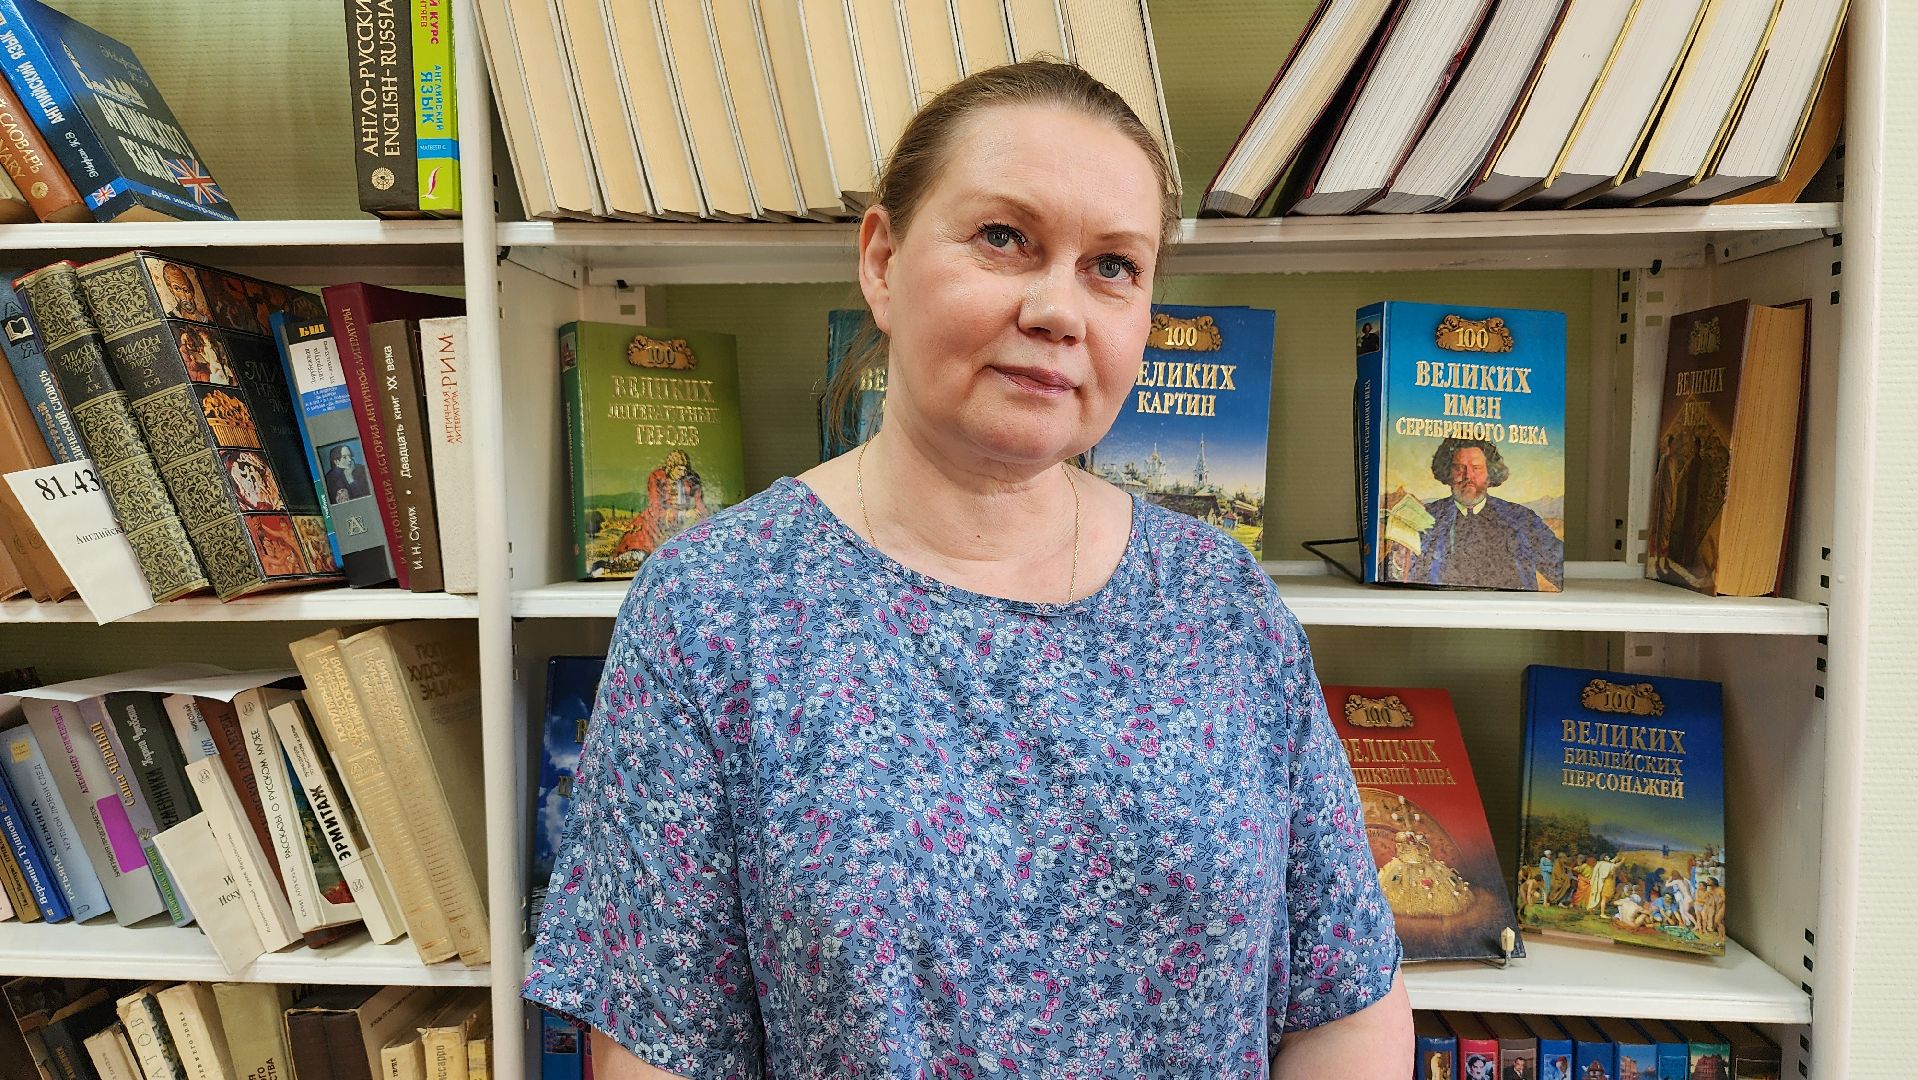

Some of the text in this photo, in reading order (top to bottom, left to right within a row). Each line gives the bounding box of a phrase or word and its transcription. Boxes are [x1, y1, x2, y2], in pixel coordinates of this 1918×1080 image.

[430, 12, 439, 45] КУРС
[0, 30, 65, 125] АНГЛИЙСКИЙ ЯЗЫК
[420, 72, 434, 124] ЯЗЫК
[434, 65, 444, 131] АНГЛИЙСКИЙ
[0, 112, 43, 174] СЛОВАРЬ
[92, 92, 195, 161] АНГЛИЙСКОГО
[340, 305, 365, 366] ЛИТЕРАТУРЫ
[1164, 326, 1199, 347] 100
[1455, 328, 1489, 349] 100
[381, 344, 395, 372] века
[648, 346, 676, 366] 100
[39, 369, 62, 412] СЛОВАРЬ
[610, 375, 716, 403] ВЕЛИКИХ
[1136, 361, 1237, 391] ЕЛИКИХ
[1415, 360, 1532, 394] ВЕЛИКИХ
[1676, 367, 1727, 396] ВЕЛИКИХ
[354, 366, 379, 421] АНТИЧНОЙ
[389, 395, 402, 420] книг
[1137, 390, 1217, 417] КАРТИН
[1443, 393, 1502, 420] ИМЕН
[443, 391, 454, 443] АНТИЧНАЯ
[451, 391, 462, 443] ЛИТЕРАТУРА
[607, 402, 720, 425] ЛИТЕРАТУРНЫХ
[634, 424, 701, 447] ГЕРОЕВ
[1395, 416, 1549, 446] СЕРЕБРЯНОГО ВЕКА
[368, 423, 390, 474] ИСТОРИЯ
[391, 422, 413, 480] Двадцать
[35, 469, 100, 500] 81.43
[404, 504, 422, 541] Сухих
[410, 541, 422, 555] Н.
[411, 557, 425, 570] И.
[314, 671, 349, 743] ПОПУЛЯРНАЯ
[330, 656, 371, 743] ЭНЦИКЛОПЕДИЯ
[1364, 706, 1393, 726] 100
[1604, 691, 1639, 711] 100
[250, 728, 266, 761] МУЗЕЕ
[1561, 719, 1687, 755] ВЕЛИКИХ
[33, 763, 46, 788] СЛЕД
[69, 753, 89, 794] АЛЕКСАНДР
[1414, 767, 1457, 785] МИРА
[1563, 746, 1683, 776] БИБЛЕЙСКИХ
[115, 774, 136, 808] Саша
[259, 758, 279, 801] РУССКОМ
[1561, 767, 1685, 799] ПЕРСОНАЖЕЙ
[146, 766, 180, 827] ЕМЕННИКИ
[272, 803, 280, 812] О
[4, 814, 28, 859] Тушнова
[274, 815, 292, 859] РАССКАЗЫ
[308, 783, 353, 861] ЭРМИТАЖ
[24, 858, 48, 904] Вероника
